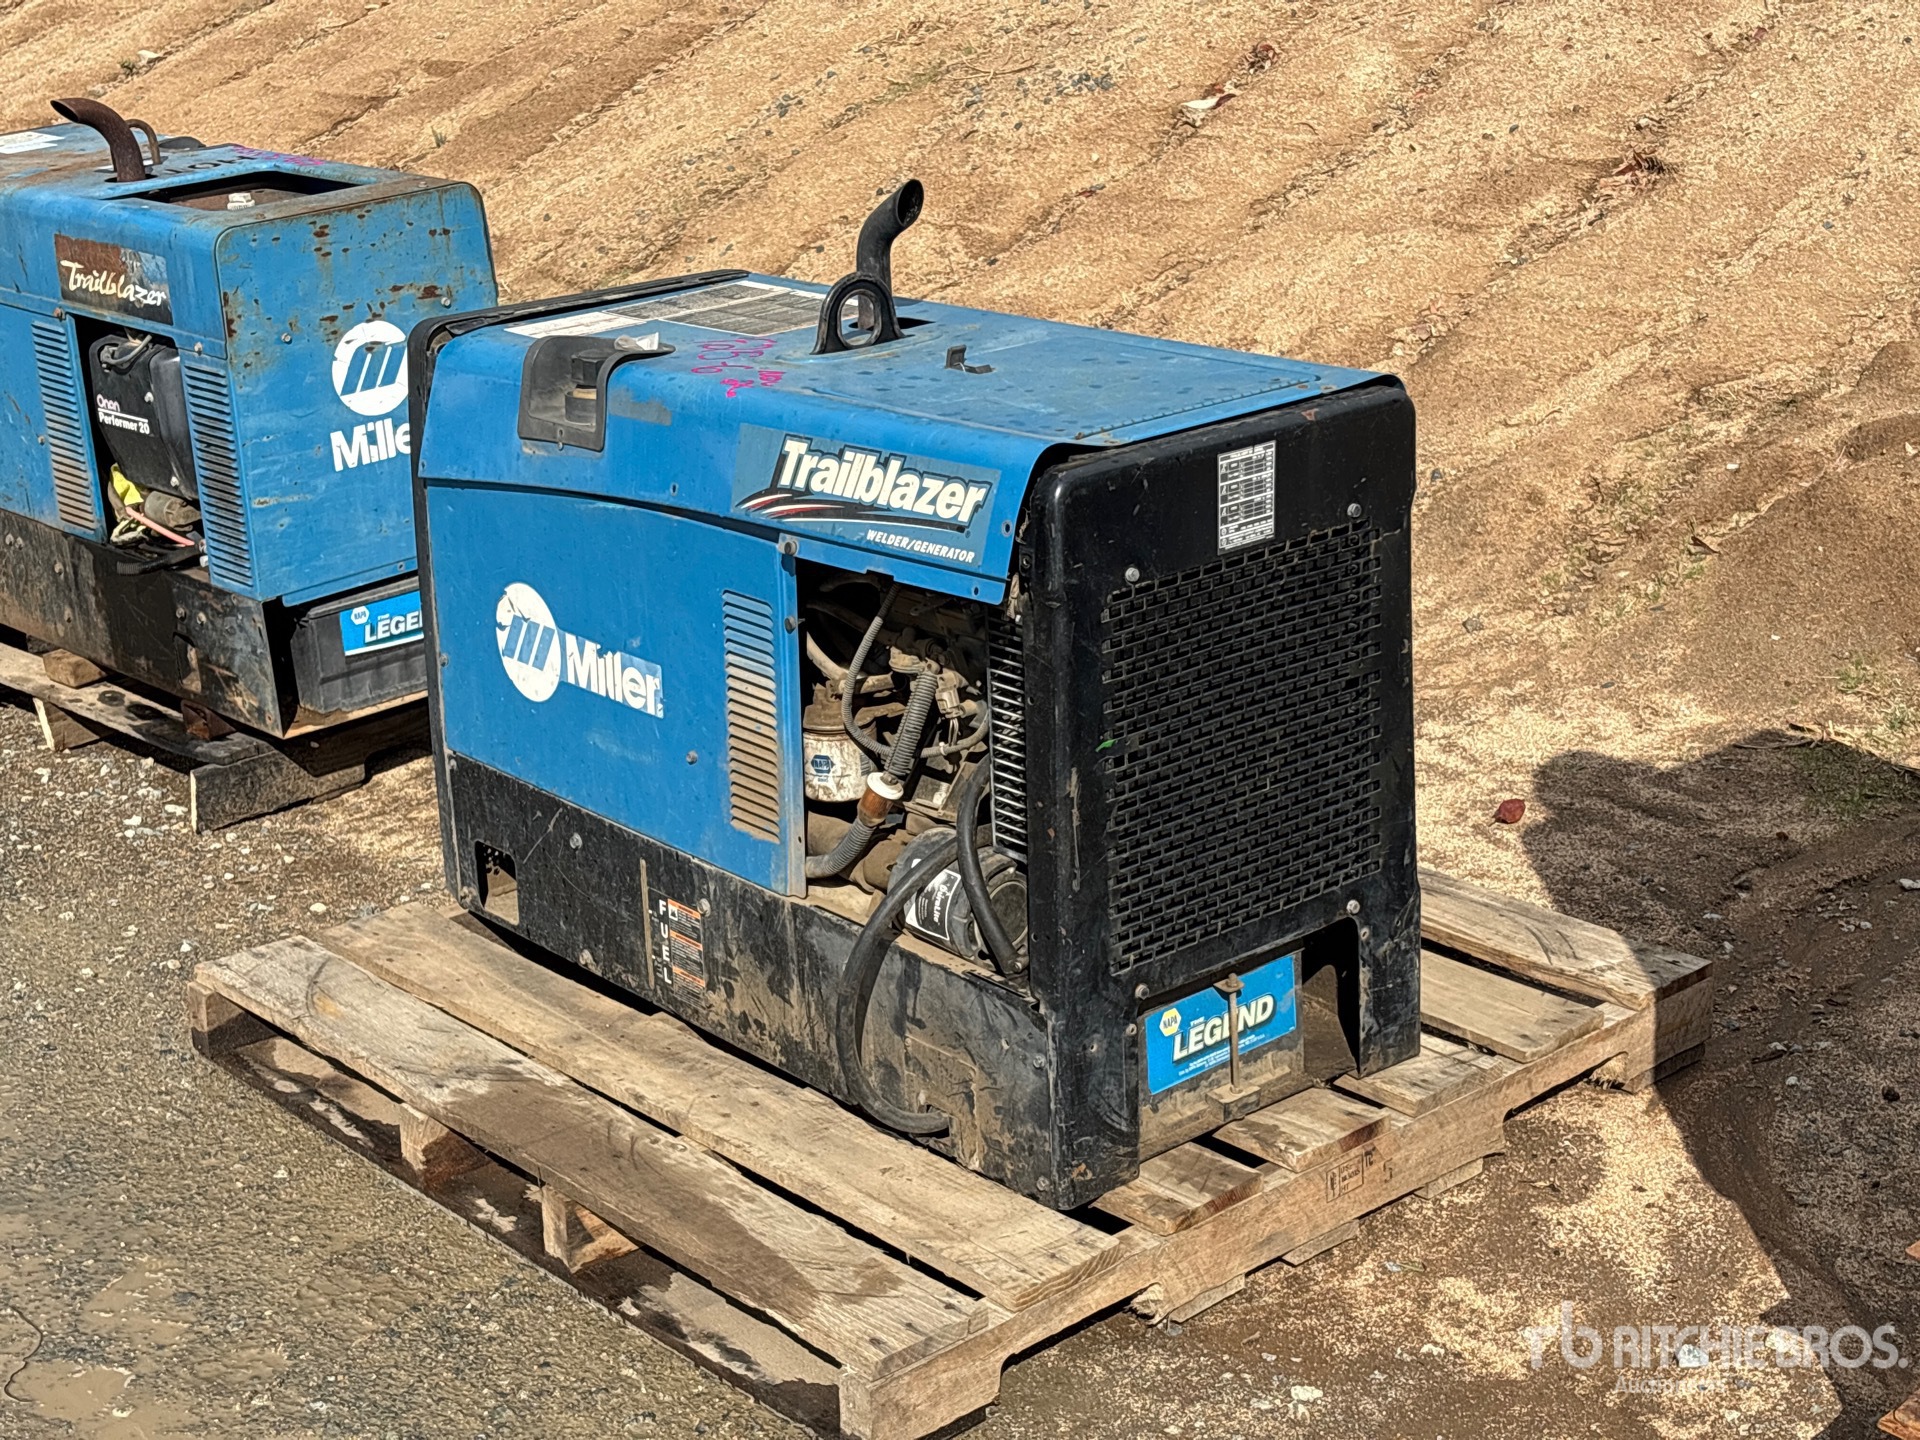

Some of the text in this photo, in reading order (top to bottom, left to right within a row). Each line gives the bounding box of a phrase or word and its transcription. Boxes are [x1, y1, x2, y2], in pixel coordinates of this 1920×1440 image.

[60, 260, 166, 306] Trailblazer
[98, 411, 150, 435] Performer 20
[779, 439, 988, 523] Trailblazer
[865, 529, 976, 564] WELDER/GENERATOR
[364, 610, 423, 644] LEGE
[565, 632, 661, 717] Miller
[1162, 1015, 1179, 1030] NAPA
